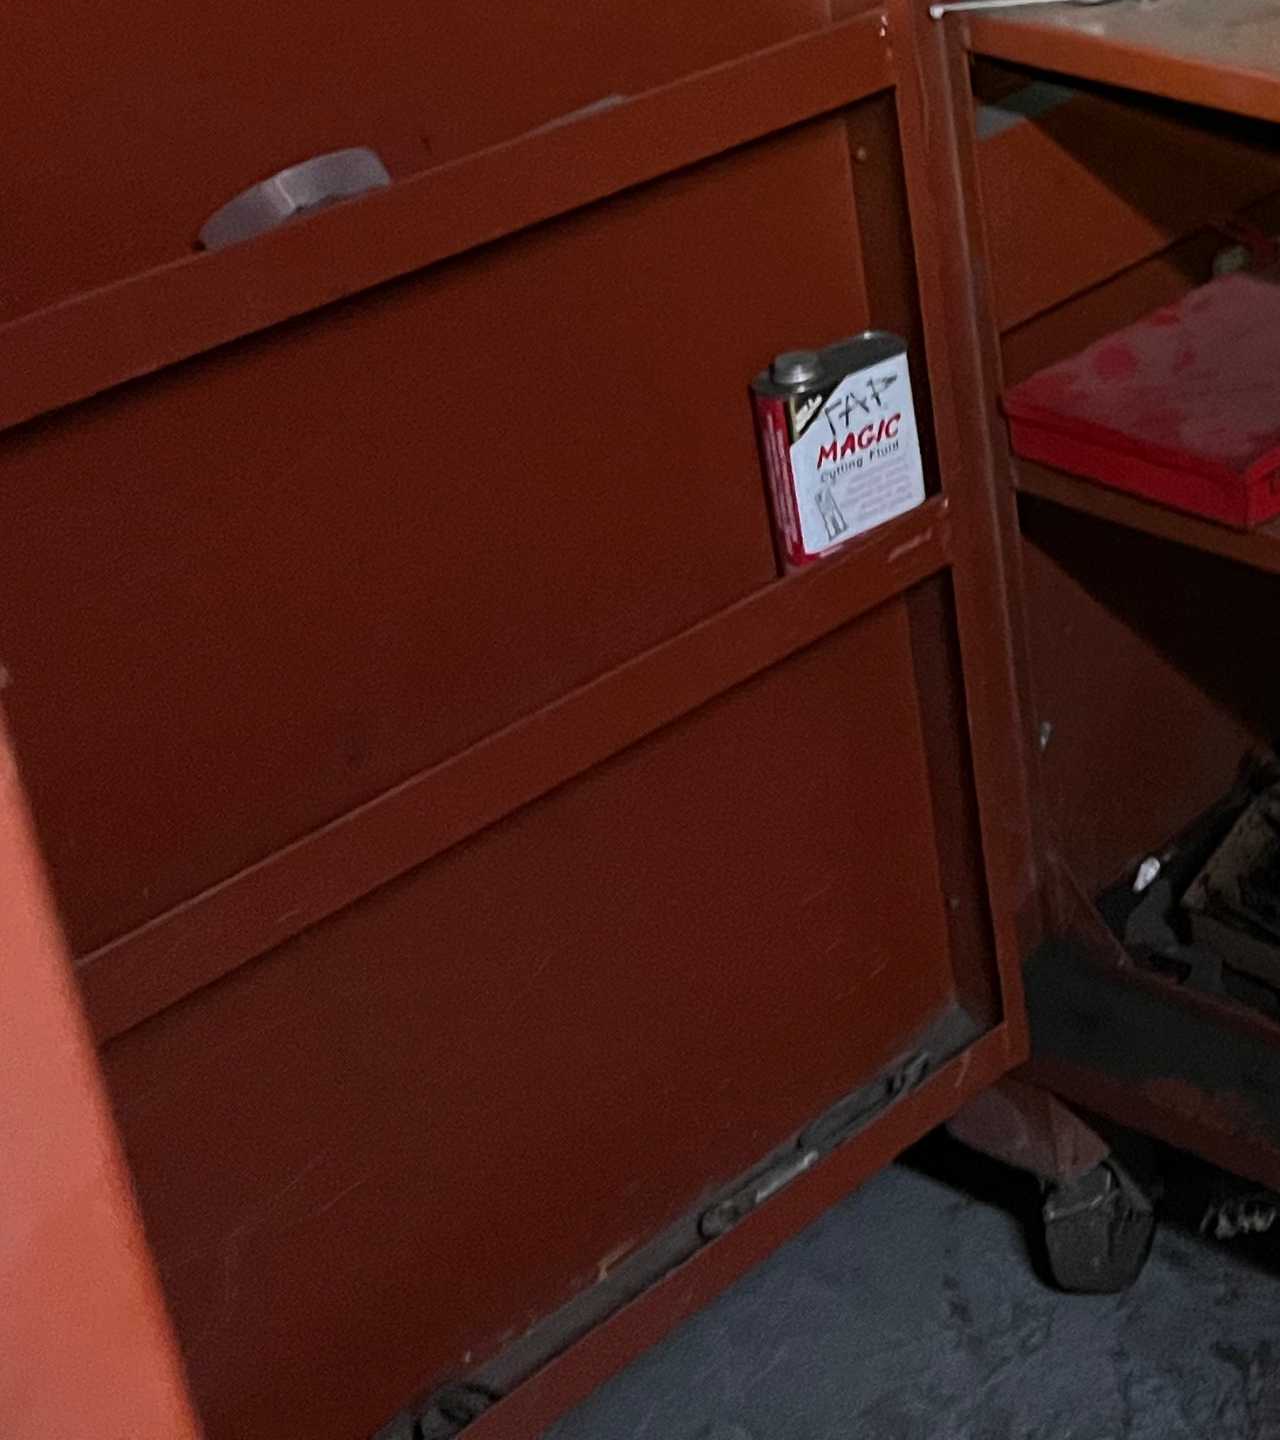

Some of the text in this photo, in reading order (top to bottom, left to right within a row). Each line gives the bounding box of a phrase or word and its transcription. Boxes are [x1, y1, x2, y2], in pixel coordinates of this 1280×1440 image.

[816, 412, 901, 470] MAGIC
[819, 439, 900, 485] Cutting Fluid
